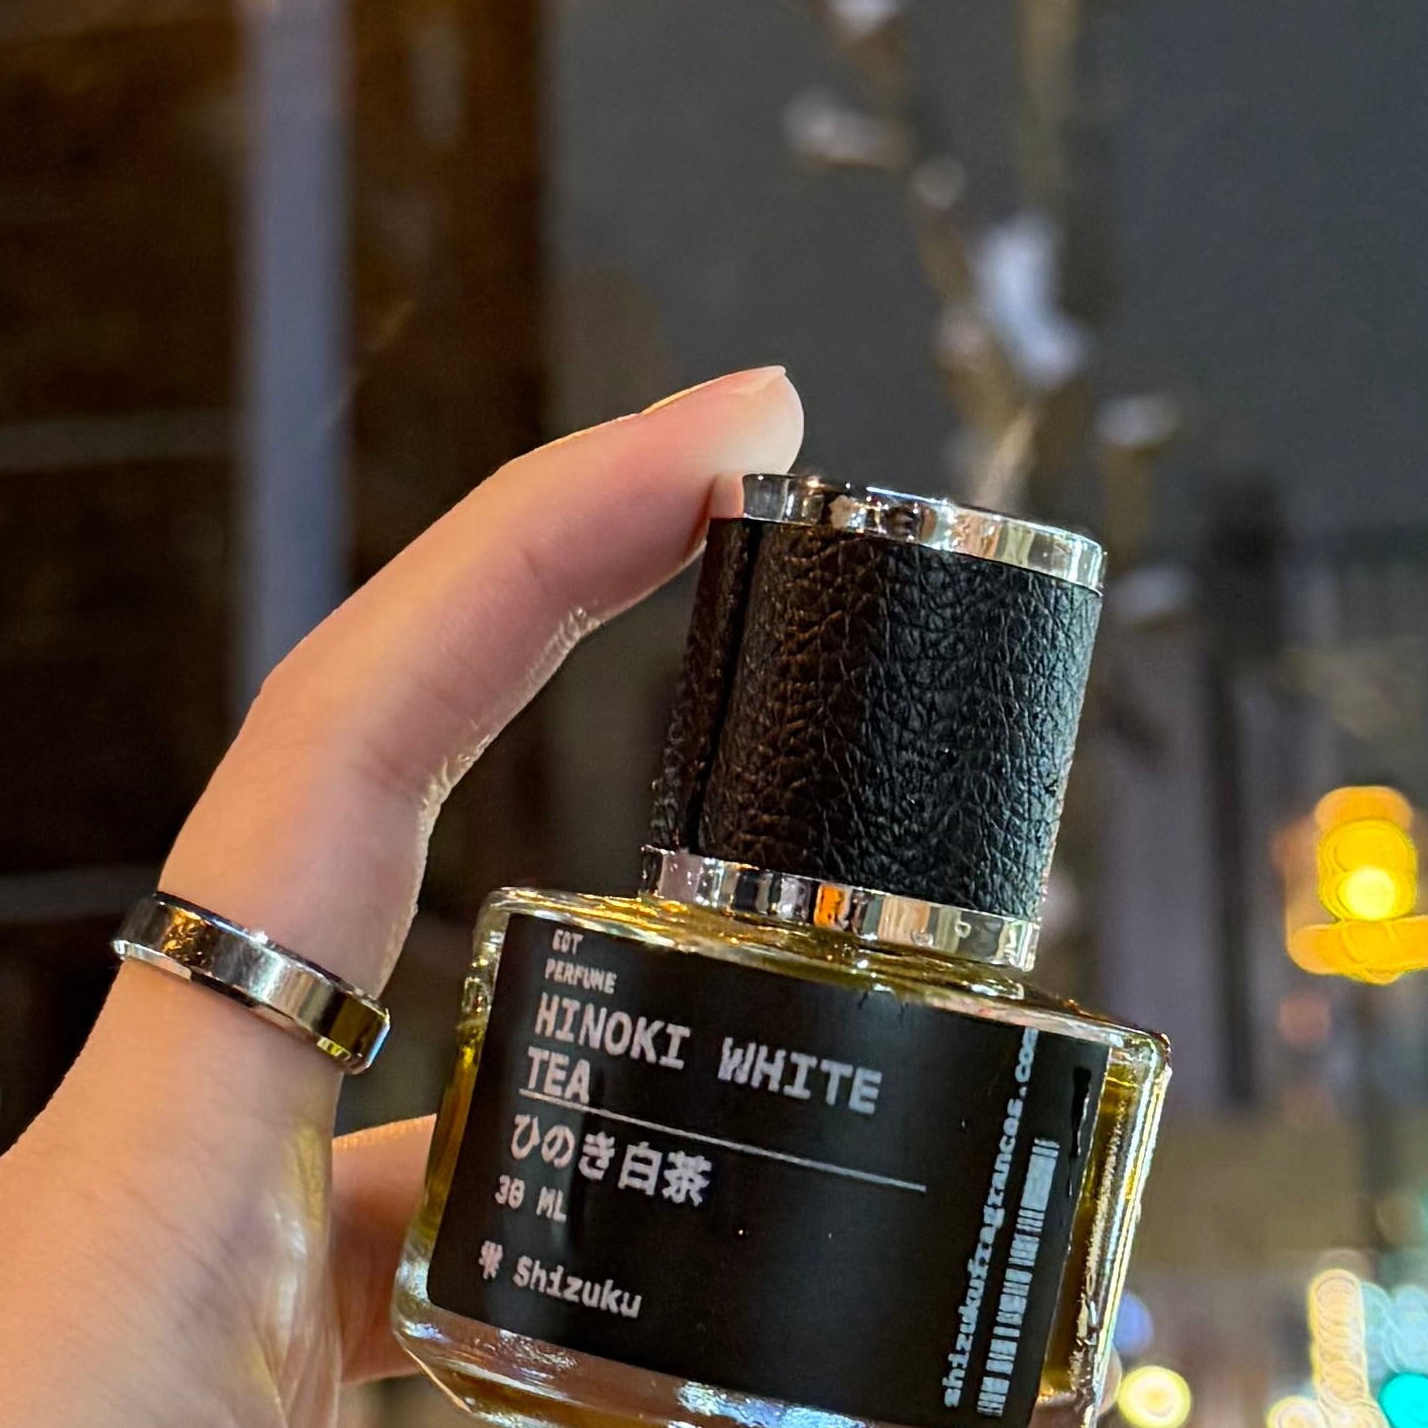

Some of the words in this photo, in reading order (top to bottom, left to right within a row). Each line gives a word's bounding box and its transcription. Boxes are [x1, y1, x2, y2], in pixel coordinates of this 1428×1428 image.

[544, 958, 617, 995] PERFUME
[527, 1045, 590, 1105] TEA
[534, 991, 691, 1070] HINOKI
[717, 1036, 882, 1114] WHITE
[510, 1113, 713, 1207] ひのき白茶
[536, 1186, 567, 1223] ML
[513, 1255, 643, 1319] Shizuku
